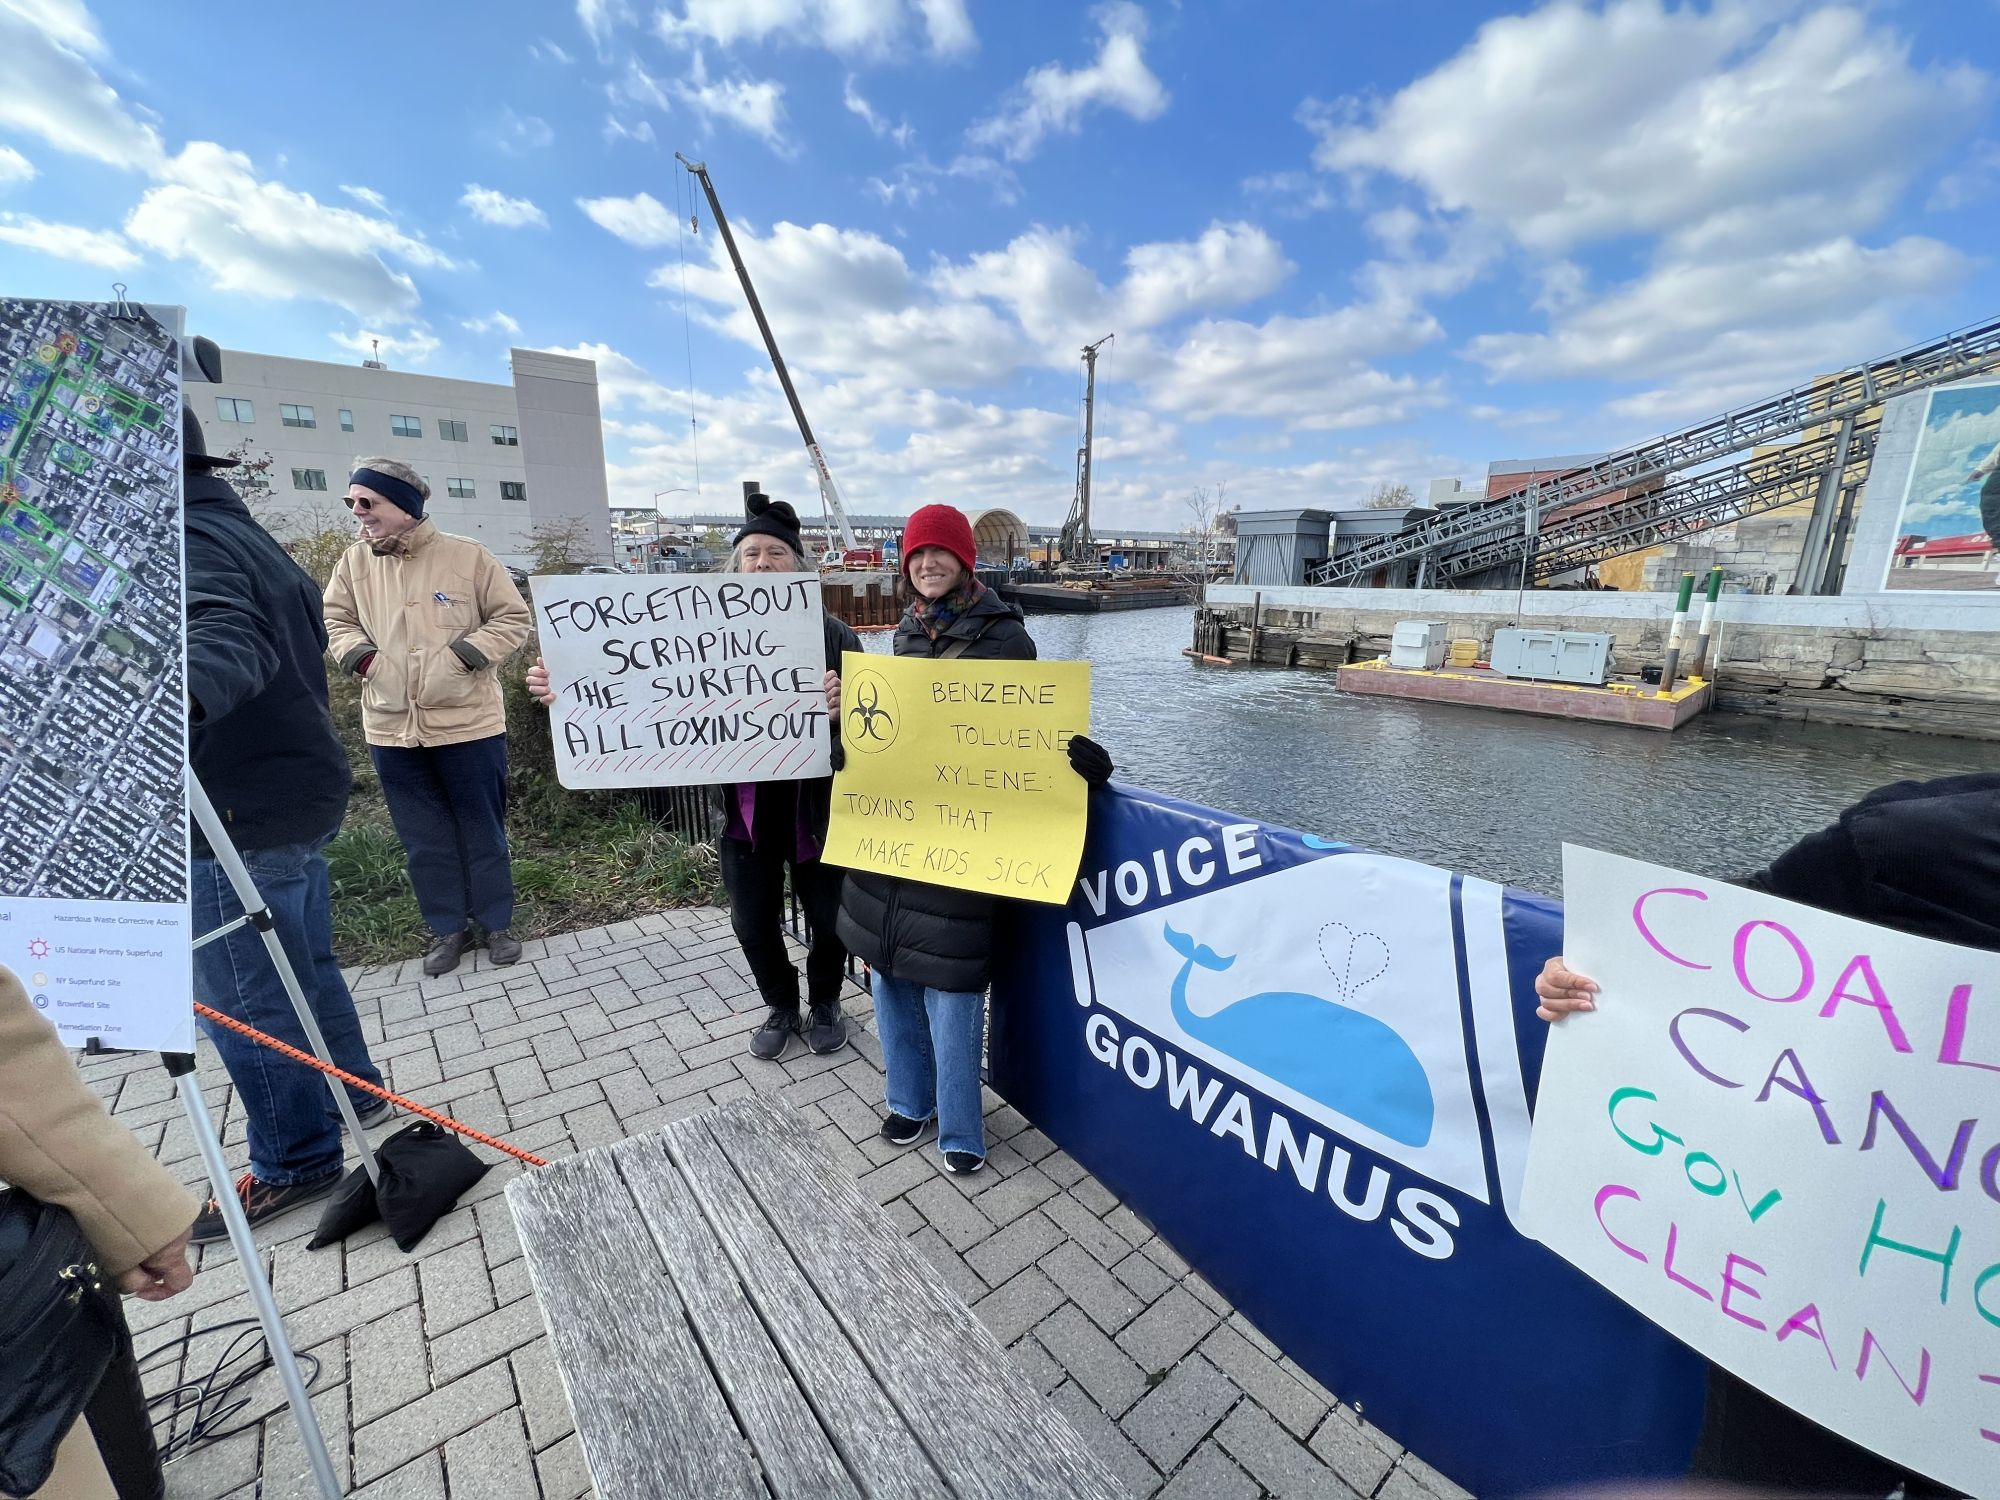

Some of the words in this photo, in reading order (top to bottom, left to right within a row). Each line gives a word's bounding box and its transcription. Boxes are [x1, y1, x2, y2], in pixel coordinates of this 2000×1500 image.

[562, 675, 629, 709] THE
[651, 663, 826, 704] SURFACE
[931, 681, 1057, 706] BENZENE
[564, 721, 642, 758] ALL
[950, 723, 1075, 752] TOLUENE
[934, 763, 1053, 793] XYLENE:
[842, 793, 915, 822] TOXINS
[934, 803, 993, 833] THAT
[855, 837, 915, 869] MAKE
[922, 847, 971, 877] KIDS
[986, 856, 1052, 889] SICK
[1079, 823, 1263, 918] VOICE
[0, 911, 12, 921] al
[54, 914, 92, 923] Hazardous
[94, 915, 117, 924] Waste
[117, 916, 155, 926] Corrective
[156, 918, 179, 927] Action
[54, 946, 66, 954] US
[67, 946, 97, 955] National
[99, 948, 124, 957] Priority
[126, 949, 163, 958] Superfund
[56, 977, 67, 985] NY
[68, 977, 106, 987] Superfund
[107, 979, 121, 987] Site
[1632, 886, 2000, 1073] COAL
[56, 1000, 95, 1009] Brownfield
[96, 1001, 111, 1010] Site
[104, 1024, 122, 1033] Zone
[1085, 1012, 1460, 1260] GOWANUS
[1593, 1183, 1932, 1408] CLEAN
